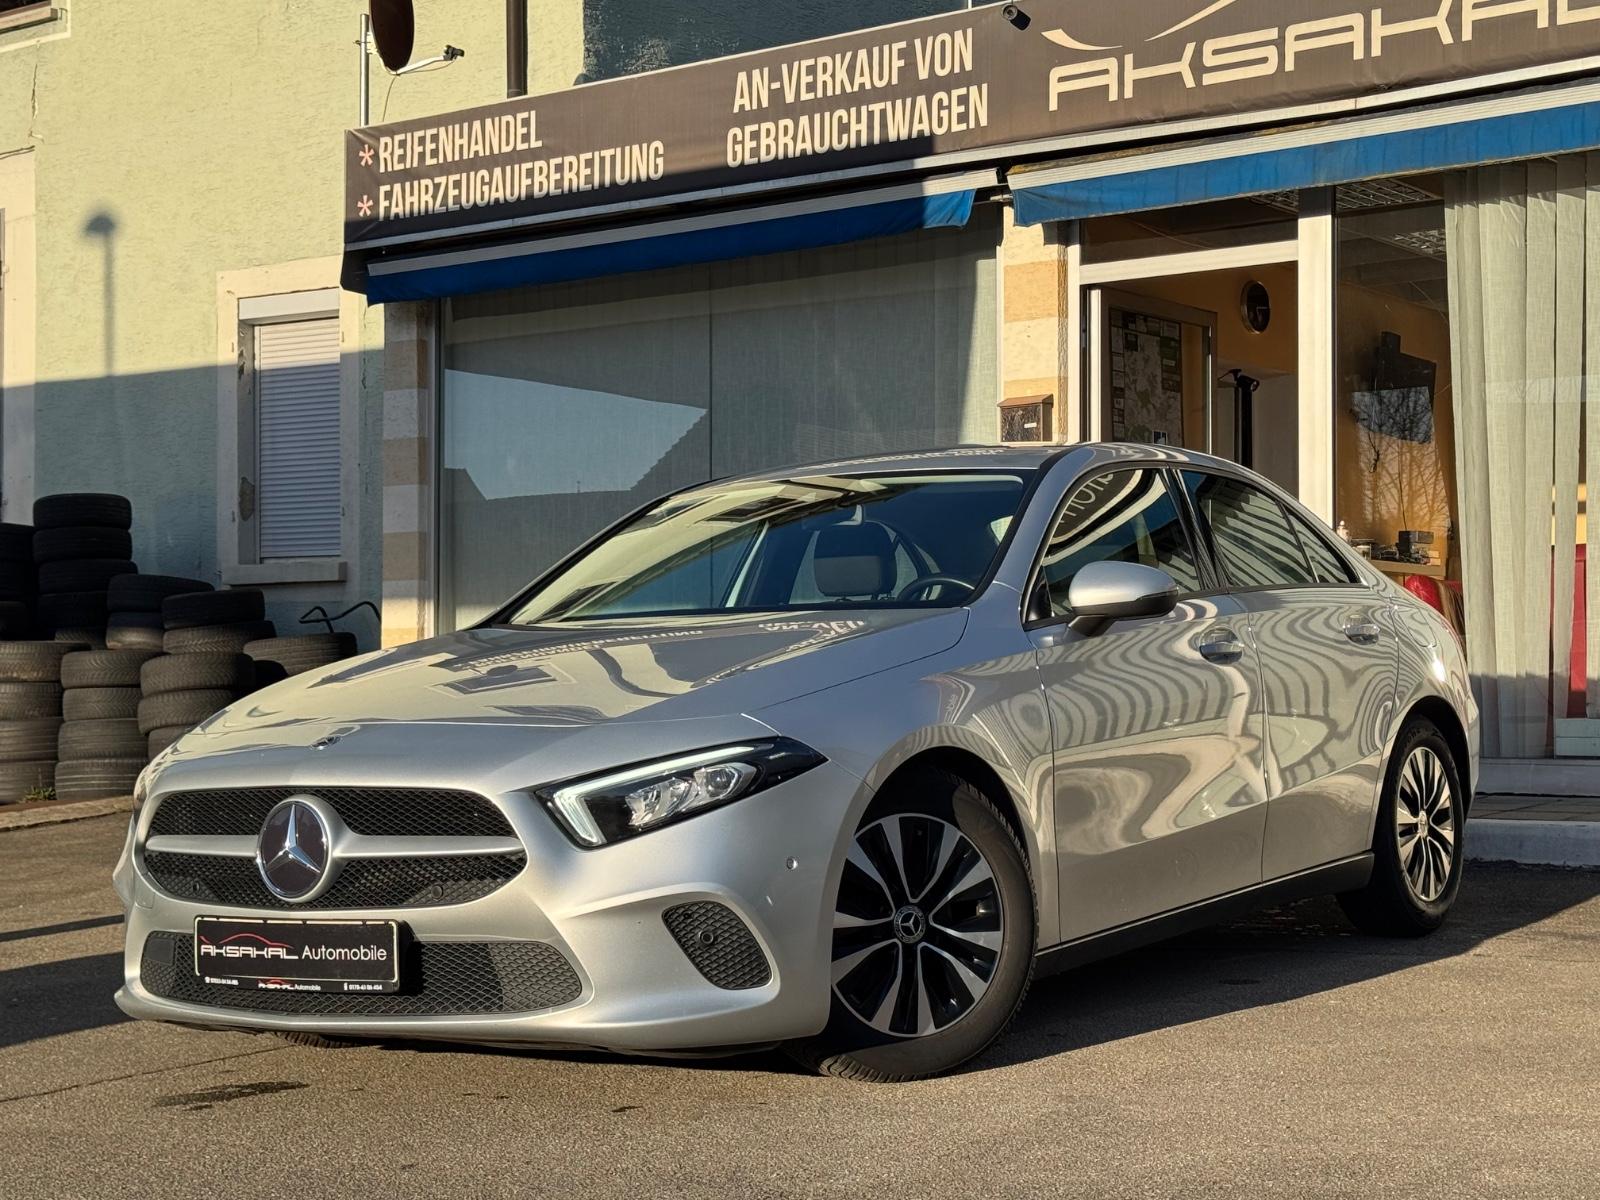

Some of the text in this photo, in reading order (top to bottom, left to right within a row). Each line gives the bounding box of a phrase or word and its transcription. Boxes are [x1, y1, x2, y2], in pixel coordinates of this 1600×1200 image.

[732, 28, 973, 114] AN-VERKAUF VON
[379, 110, 543, 173] REIFENHANDEL
[726, 83, 988, 168] GEBRAUCHTWAGEN
[378, 140, 664, 222] FAHRZEUGAUFBEREITUNG
[200, 944, 388, 961] AKSAKAL Automobile
